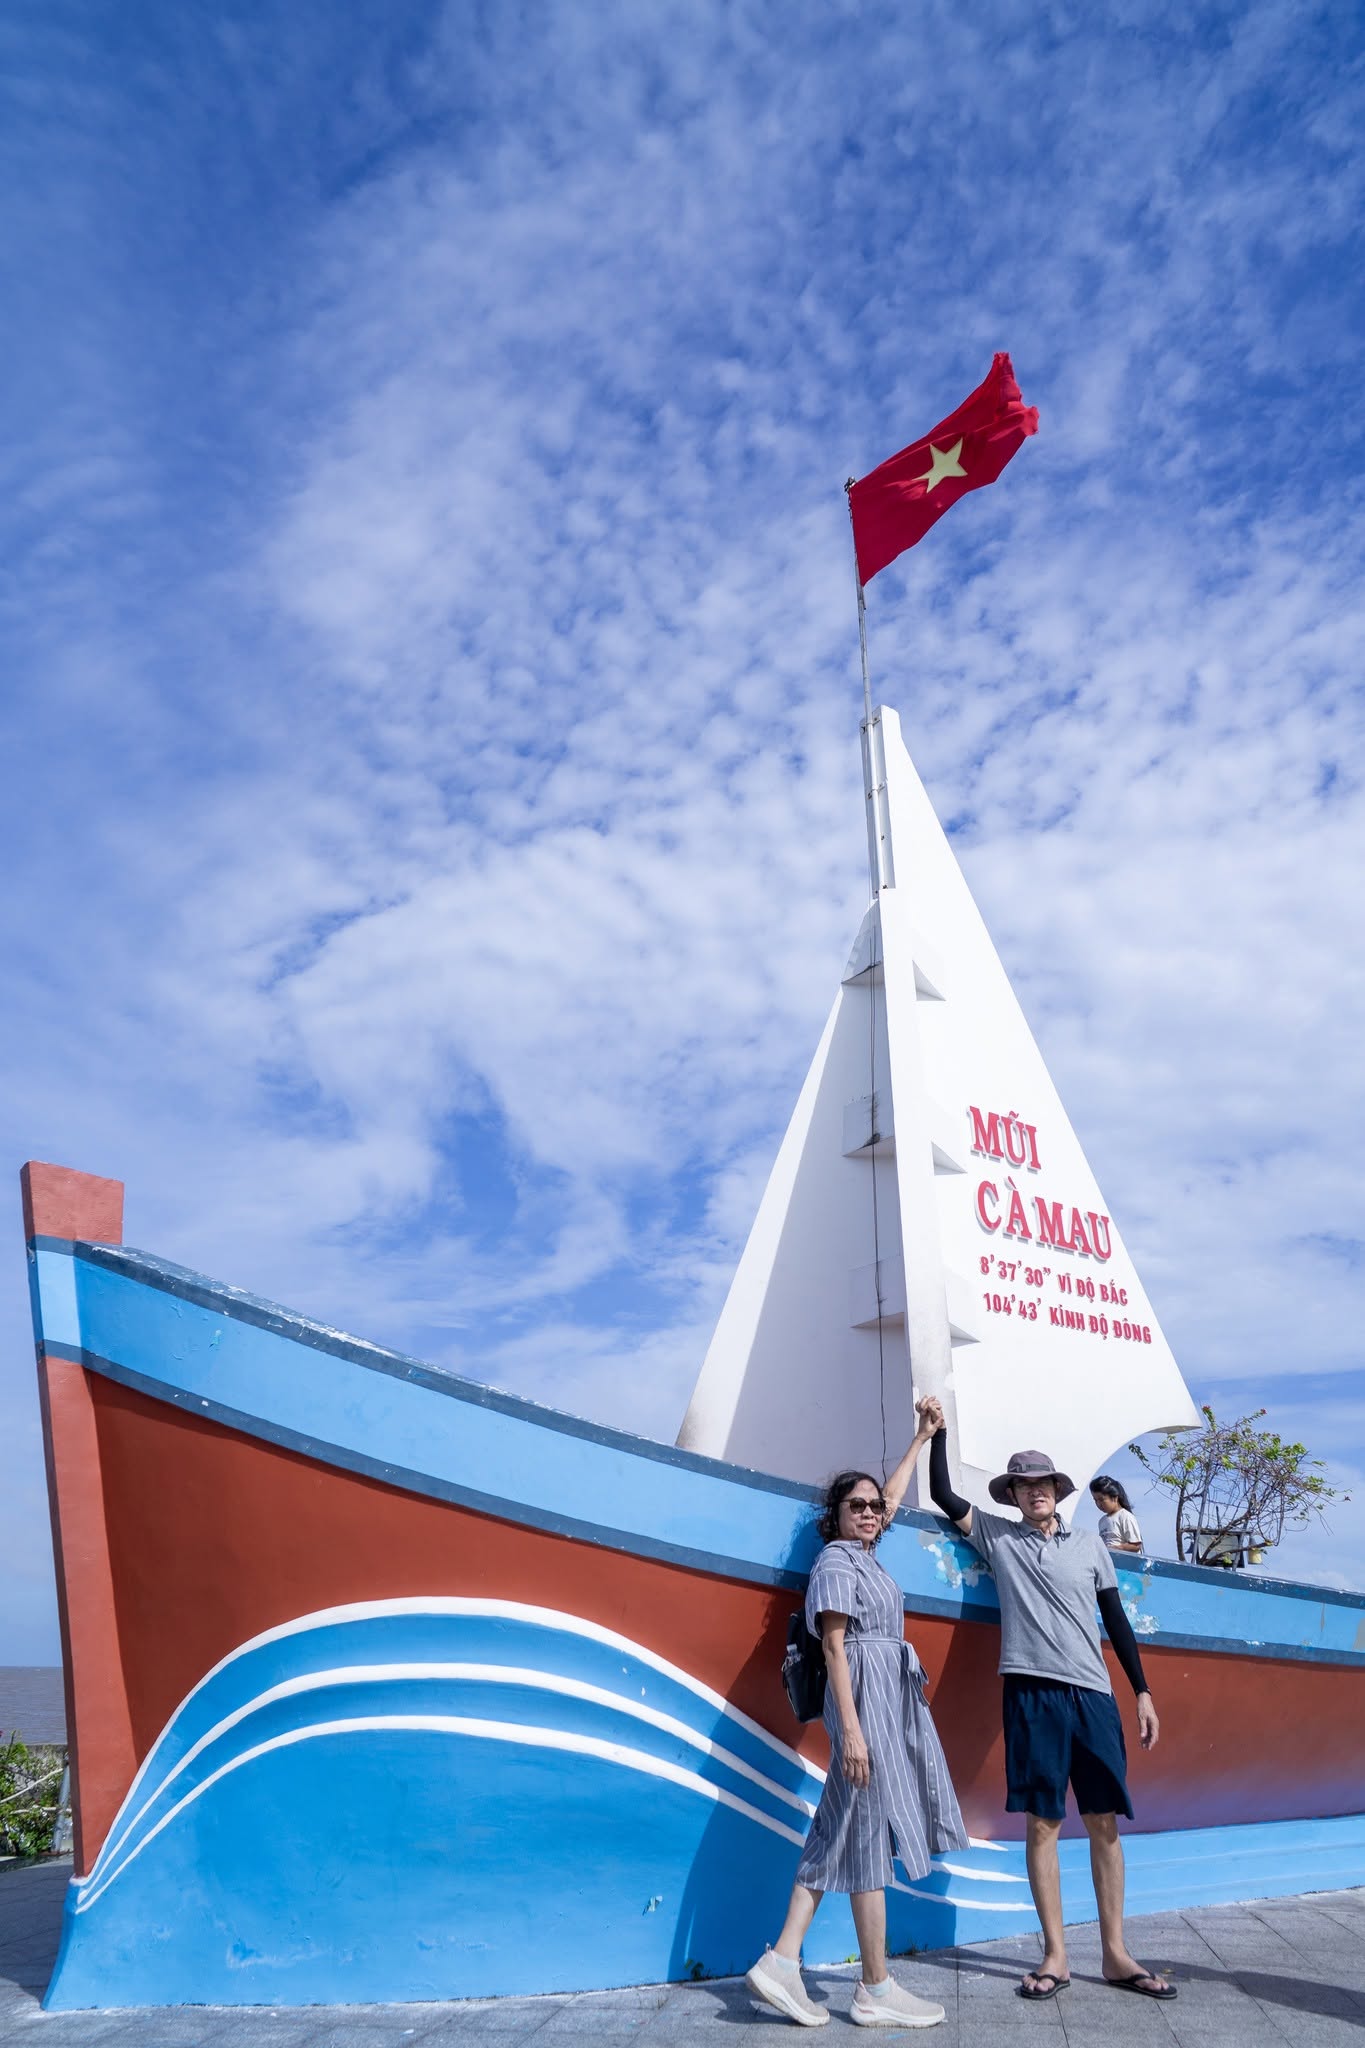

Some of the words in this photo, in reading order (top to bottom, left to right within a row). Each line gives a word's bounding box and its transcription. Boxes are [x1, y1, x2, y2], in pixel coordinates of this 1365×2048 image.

[968, 1105, 1042, 1170] MŨI
[976, 1175, 1033, 1240] CÀ
[1033, 1195, 1113, 1261] MAU
[1075, 1276, 1096, 1304] ĐỘ
[1099, 1278, 1129, 1307] BẮC
[1088, 1312, 1109, 1341] ĐỘ
[1112, 1317, 1153, 1345] ĐÔNG
